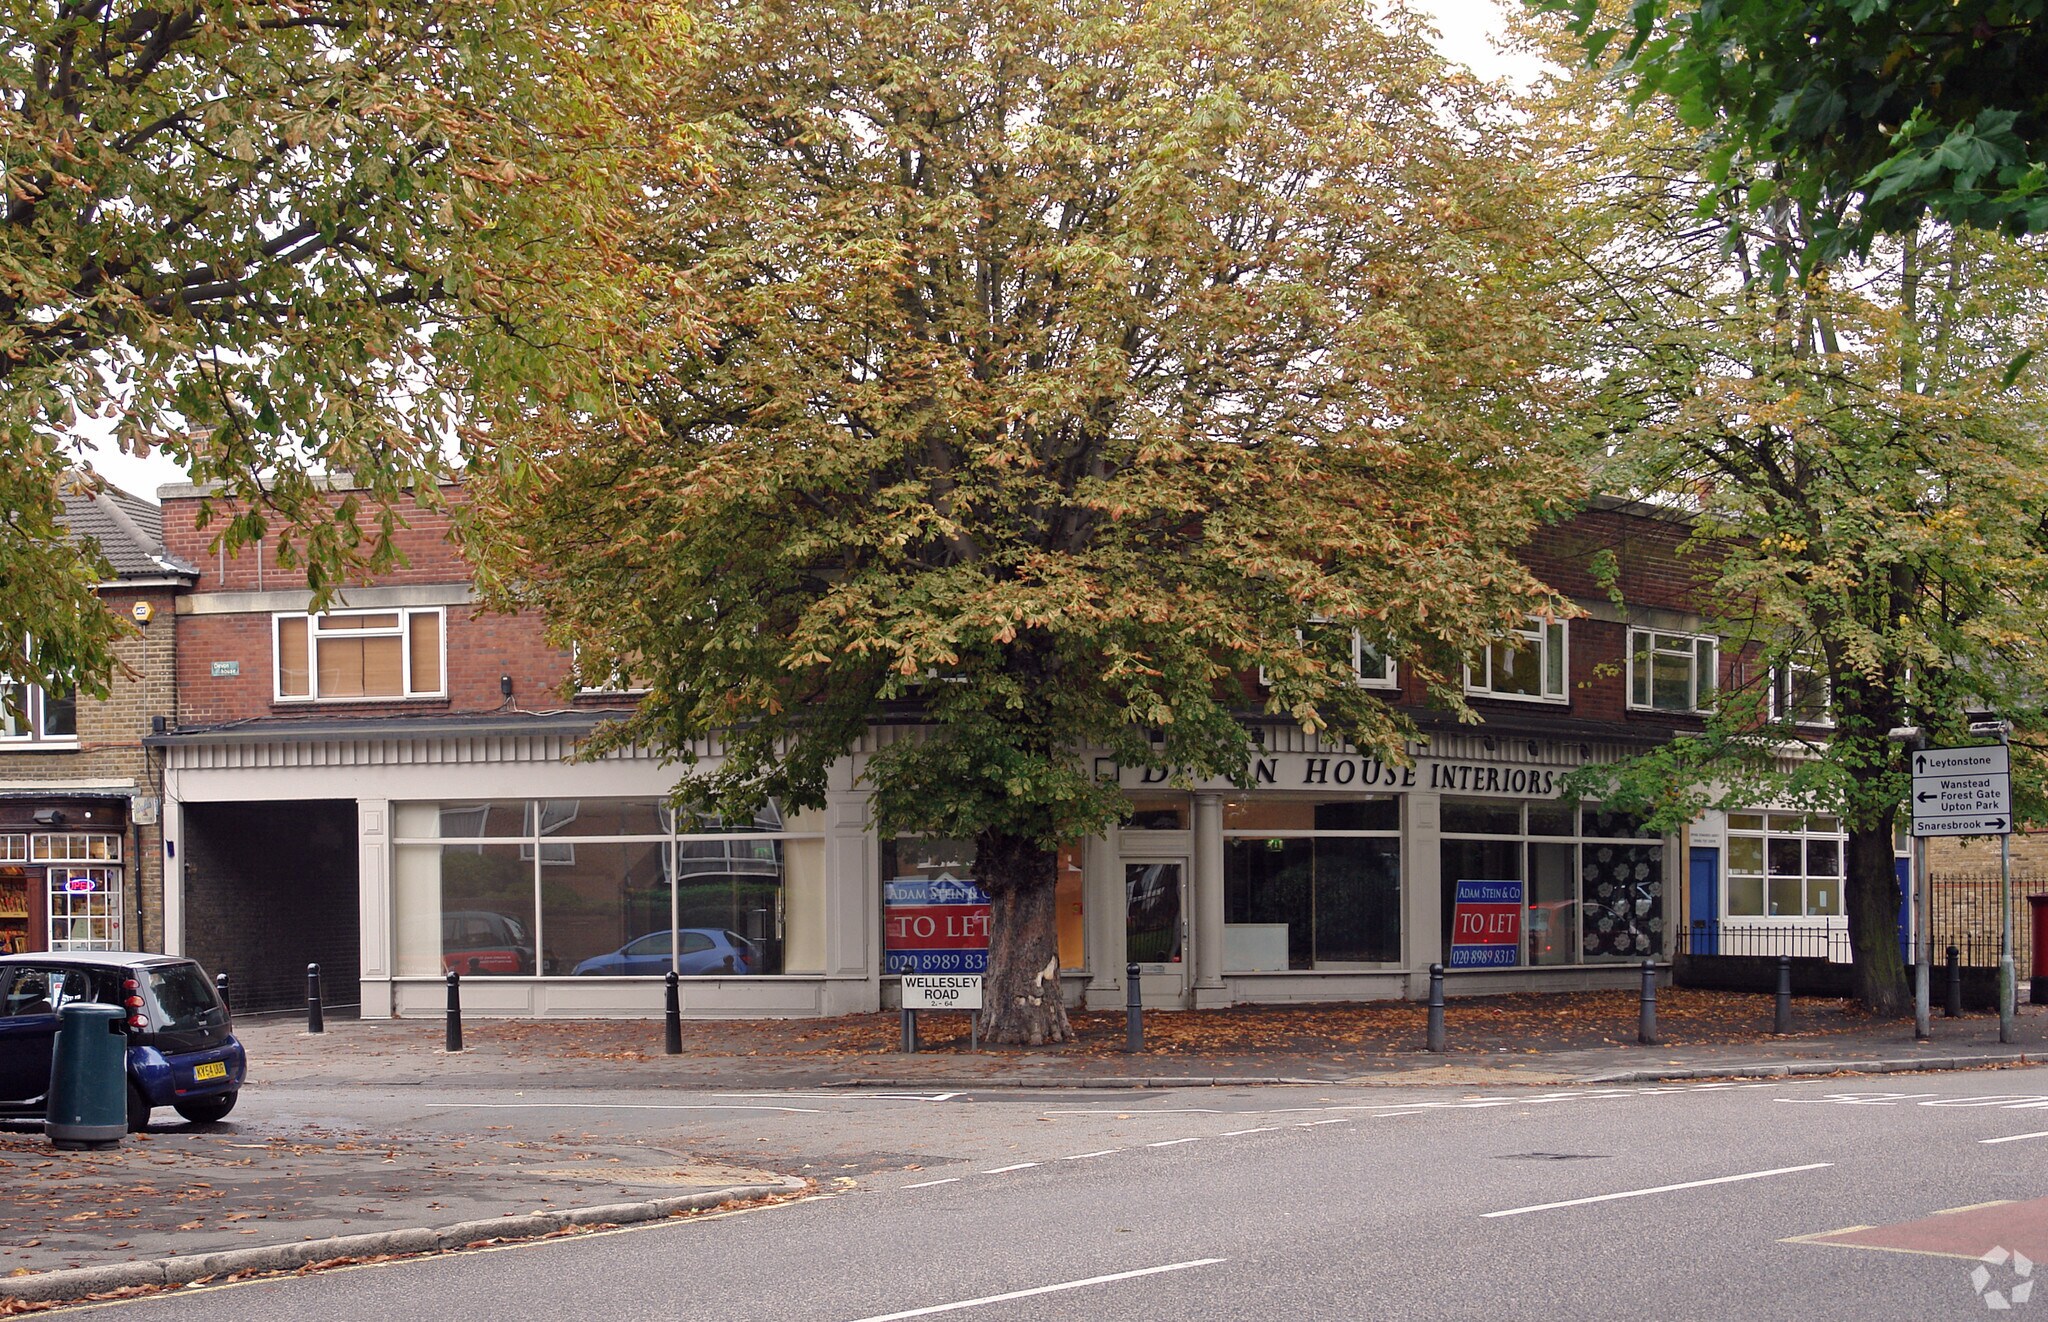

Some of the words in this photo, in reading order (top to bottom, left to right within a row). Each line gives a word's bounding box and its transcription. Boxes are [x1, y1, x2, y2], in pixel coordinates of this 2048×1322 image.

[1930, 756, 1991, 768] Leytonstone
[1303, 758, 1417, 787] HOUSE
[1430, 763, 1554, 794] INTERIORS
[1940, 779, 1990, 789] Wanstead
[1941, 791, 1972, 800] Forest
[1976, 789, 2001, 799] Gate
[1941, 802, 1972, 812] Upton
[1976, 801, 1999, 810] Park
[1918, 820, 1981, 831] Snaresbrook
[889, 887, 926, 900] ADAM
[930, 886, 964, 900] STEIN
[967, 886, 979, 900] &
[1459, 887, 1480, 898] ADAM
[1482, 886, 1501, 899] STEIN
[1502, 887, 1508, 898] &
[894, 915, 936, 938] TO
[946, 915, 990, 937] LET
[1461, 913, 1484, 934] TO
[1489, 913, 1516, 933] LET
[890, 954, 918, 970] 020
[922, 954, 960, 970] 8989
[1453, 950, 1470, 965] 020
[1471, 949, 1493, 964] 8989
[1494, 949, 1515, 963] 8313
[905, 977, 978, 988] WELLESLEY
[924, 989, 959, 1000] ROAD
